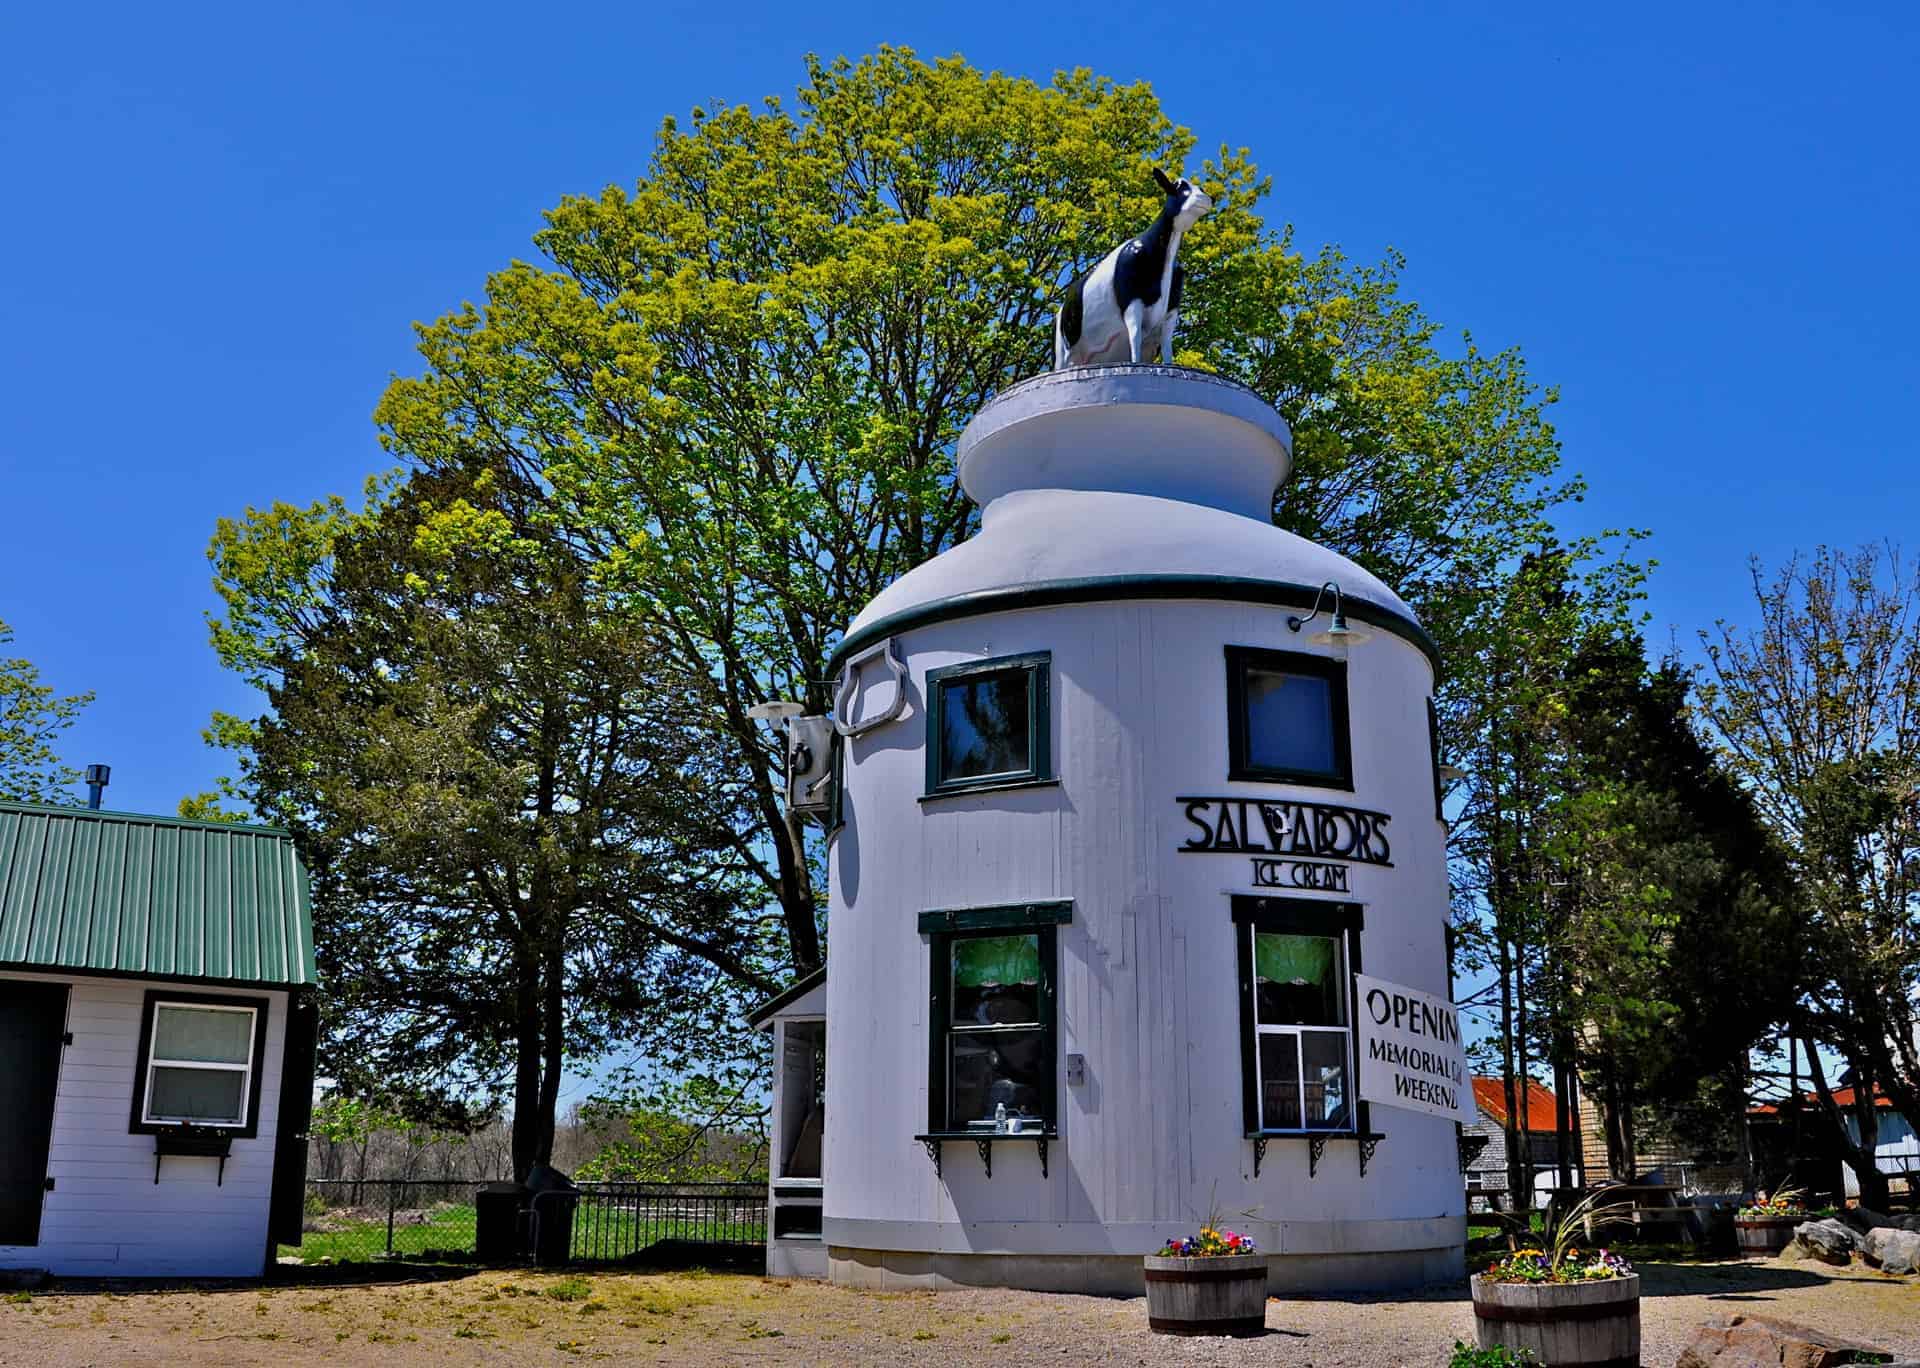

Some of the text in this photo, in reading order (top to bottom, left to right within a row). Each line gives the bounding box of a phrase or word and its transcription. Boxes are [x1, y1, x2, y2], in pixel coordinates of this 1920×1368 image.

[1184, 798, 1391, 866] SALVADORS
[1253, 859, 1348, 891] ICE CREAM
[1369, 1037, 1452, 1079] MEMORIAL
[1394, 1073, 1459, 1110] WEEKEND
